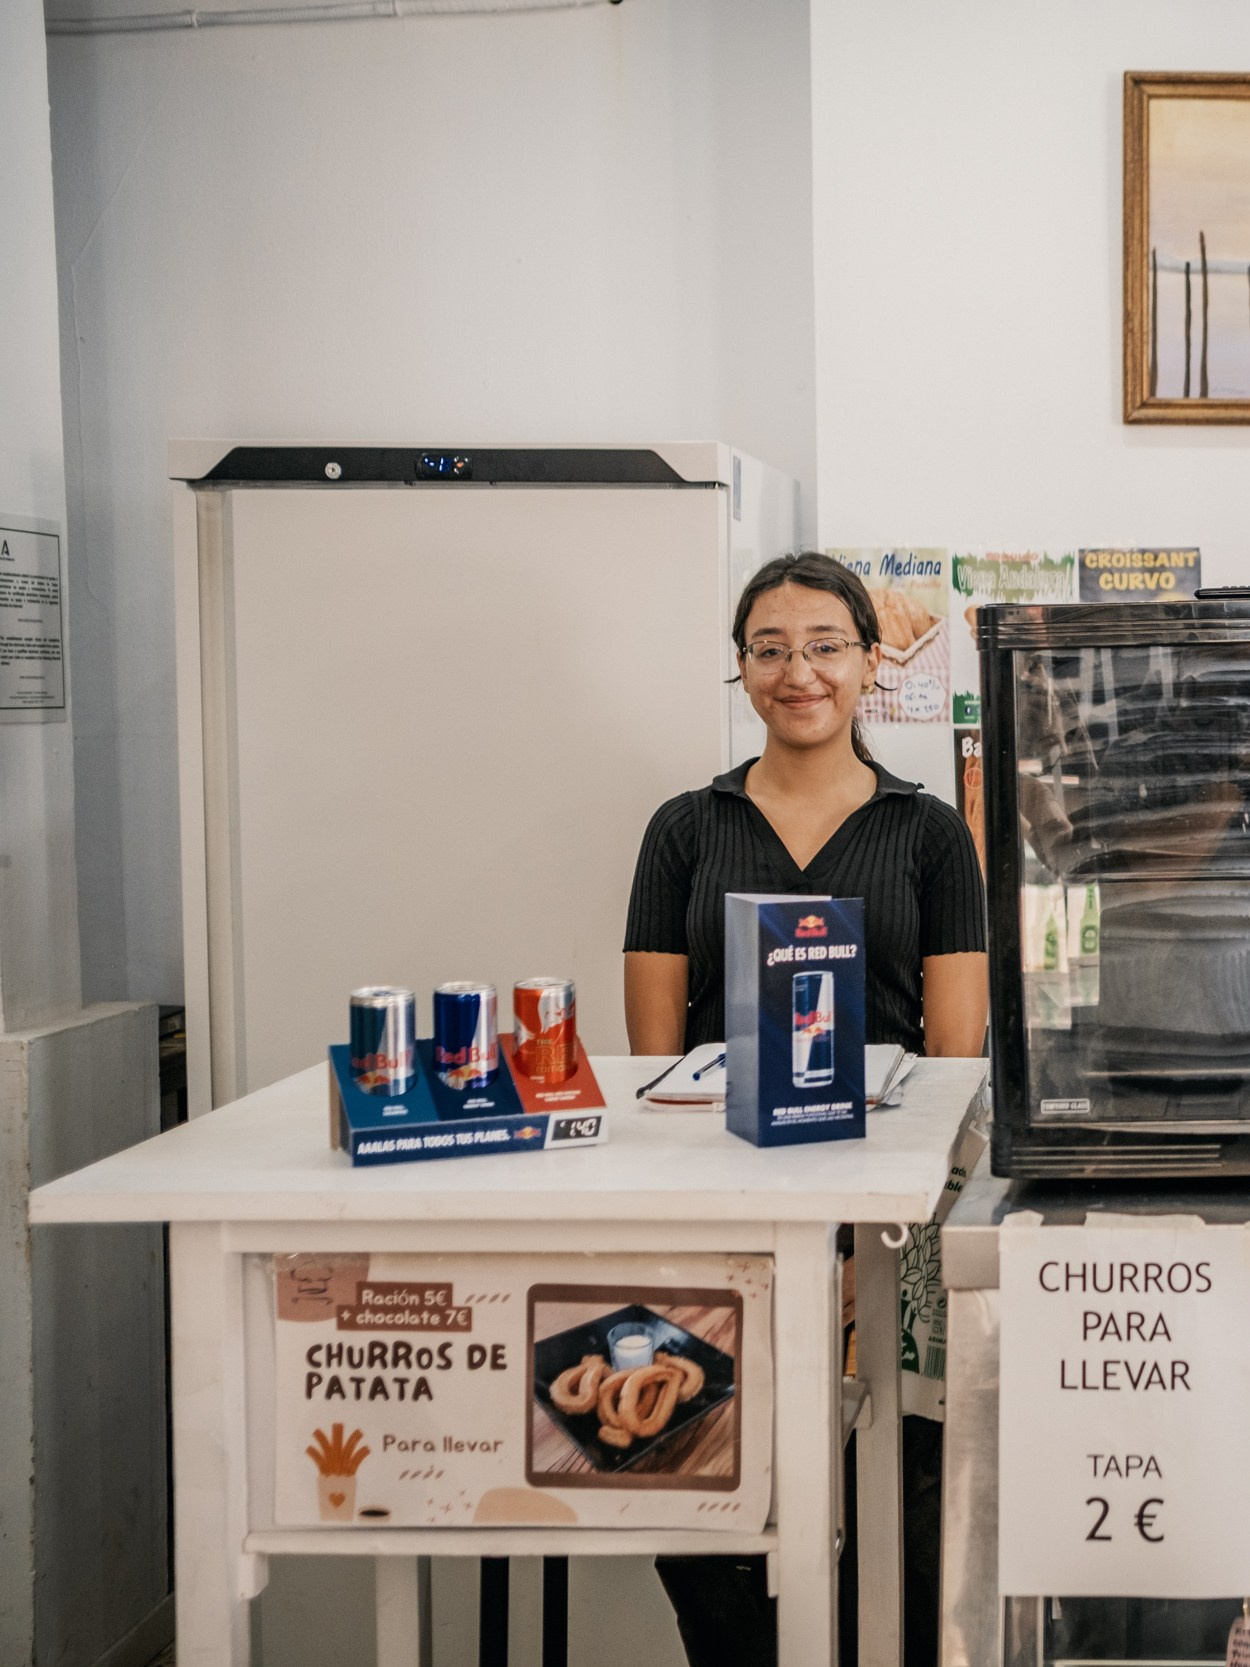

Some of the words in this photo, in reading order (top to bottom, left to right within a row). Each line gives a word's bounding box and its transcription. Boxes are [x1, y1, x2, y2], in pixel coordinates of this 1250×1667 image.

[832, 554, 871, 576] iena
[879, 552, 942, 576] Mediana
[1085, 551, 1198, 570] CROISSANT
[957, 565, 996, 589] Viena
[1099, 571, 1175, 591] CURVO
[962, 736, 981, 758] Ba
[767, 944, 794, 966] ¿QUÉ
[795, 947, 807, 961] ES
[808, 946, 827, 960] RED
[828, 944, 858, 959] BULL?
[396, 1138, 423, 1151] PARA
[423, 1134, 455, 1148] TODOS
[455, 1132, 474, 1145] TUS
[1039, 1261, 1212, 1293] CHURROS
[361, 1289, 421, 1306] Ración
[424, 1290, 447, 1306] 5€
[356, 1308, 440, 1327] chocolate
[445, 1309, 469, 1326] 7€
[1082, 1311, 1172, 1342] PARA
[306, 1340, 453, 1371] CHURROS
[466, 1342, 508, 1371] DE
[306, 1372, 434, 1401] PATATA
[1061, 1360, 1190, 1391] LLEVAR
[382, 1434, 436, 1455] Para
[442, 1434, 504, 1455] llevar
[1086, 1454, 1162, 1479] TAPA
[1085, 1497, 1112, 1542] 2
[1134, 1498, 1165, 1542] €
